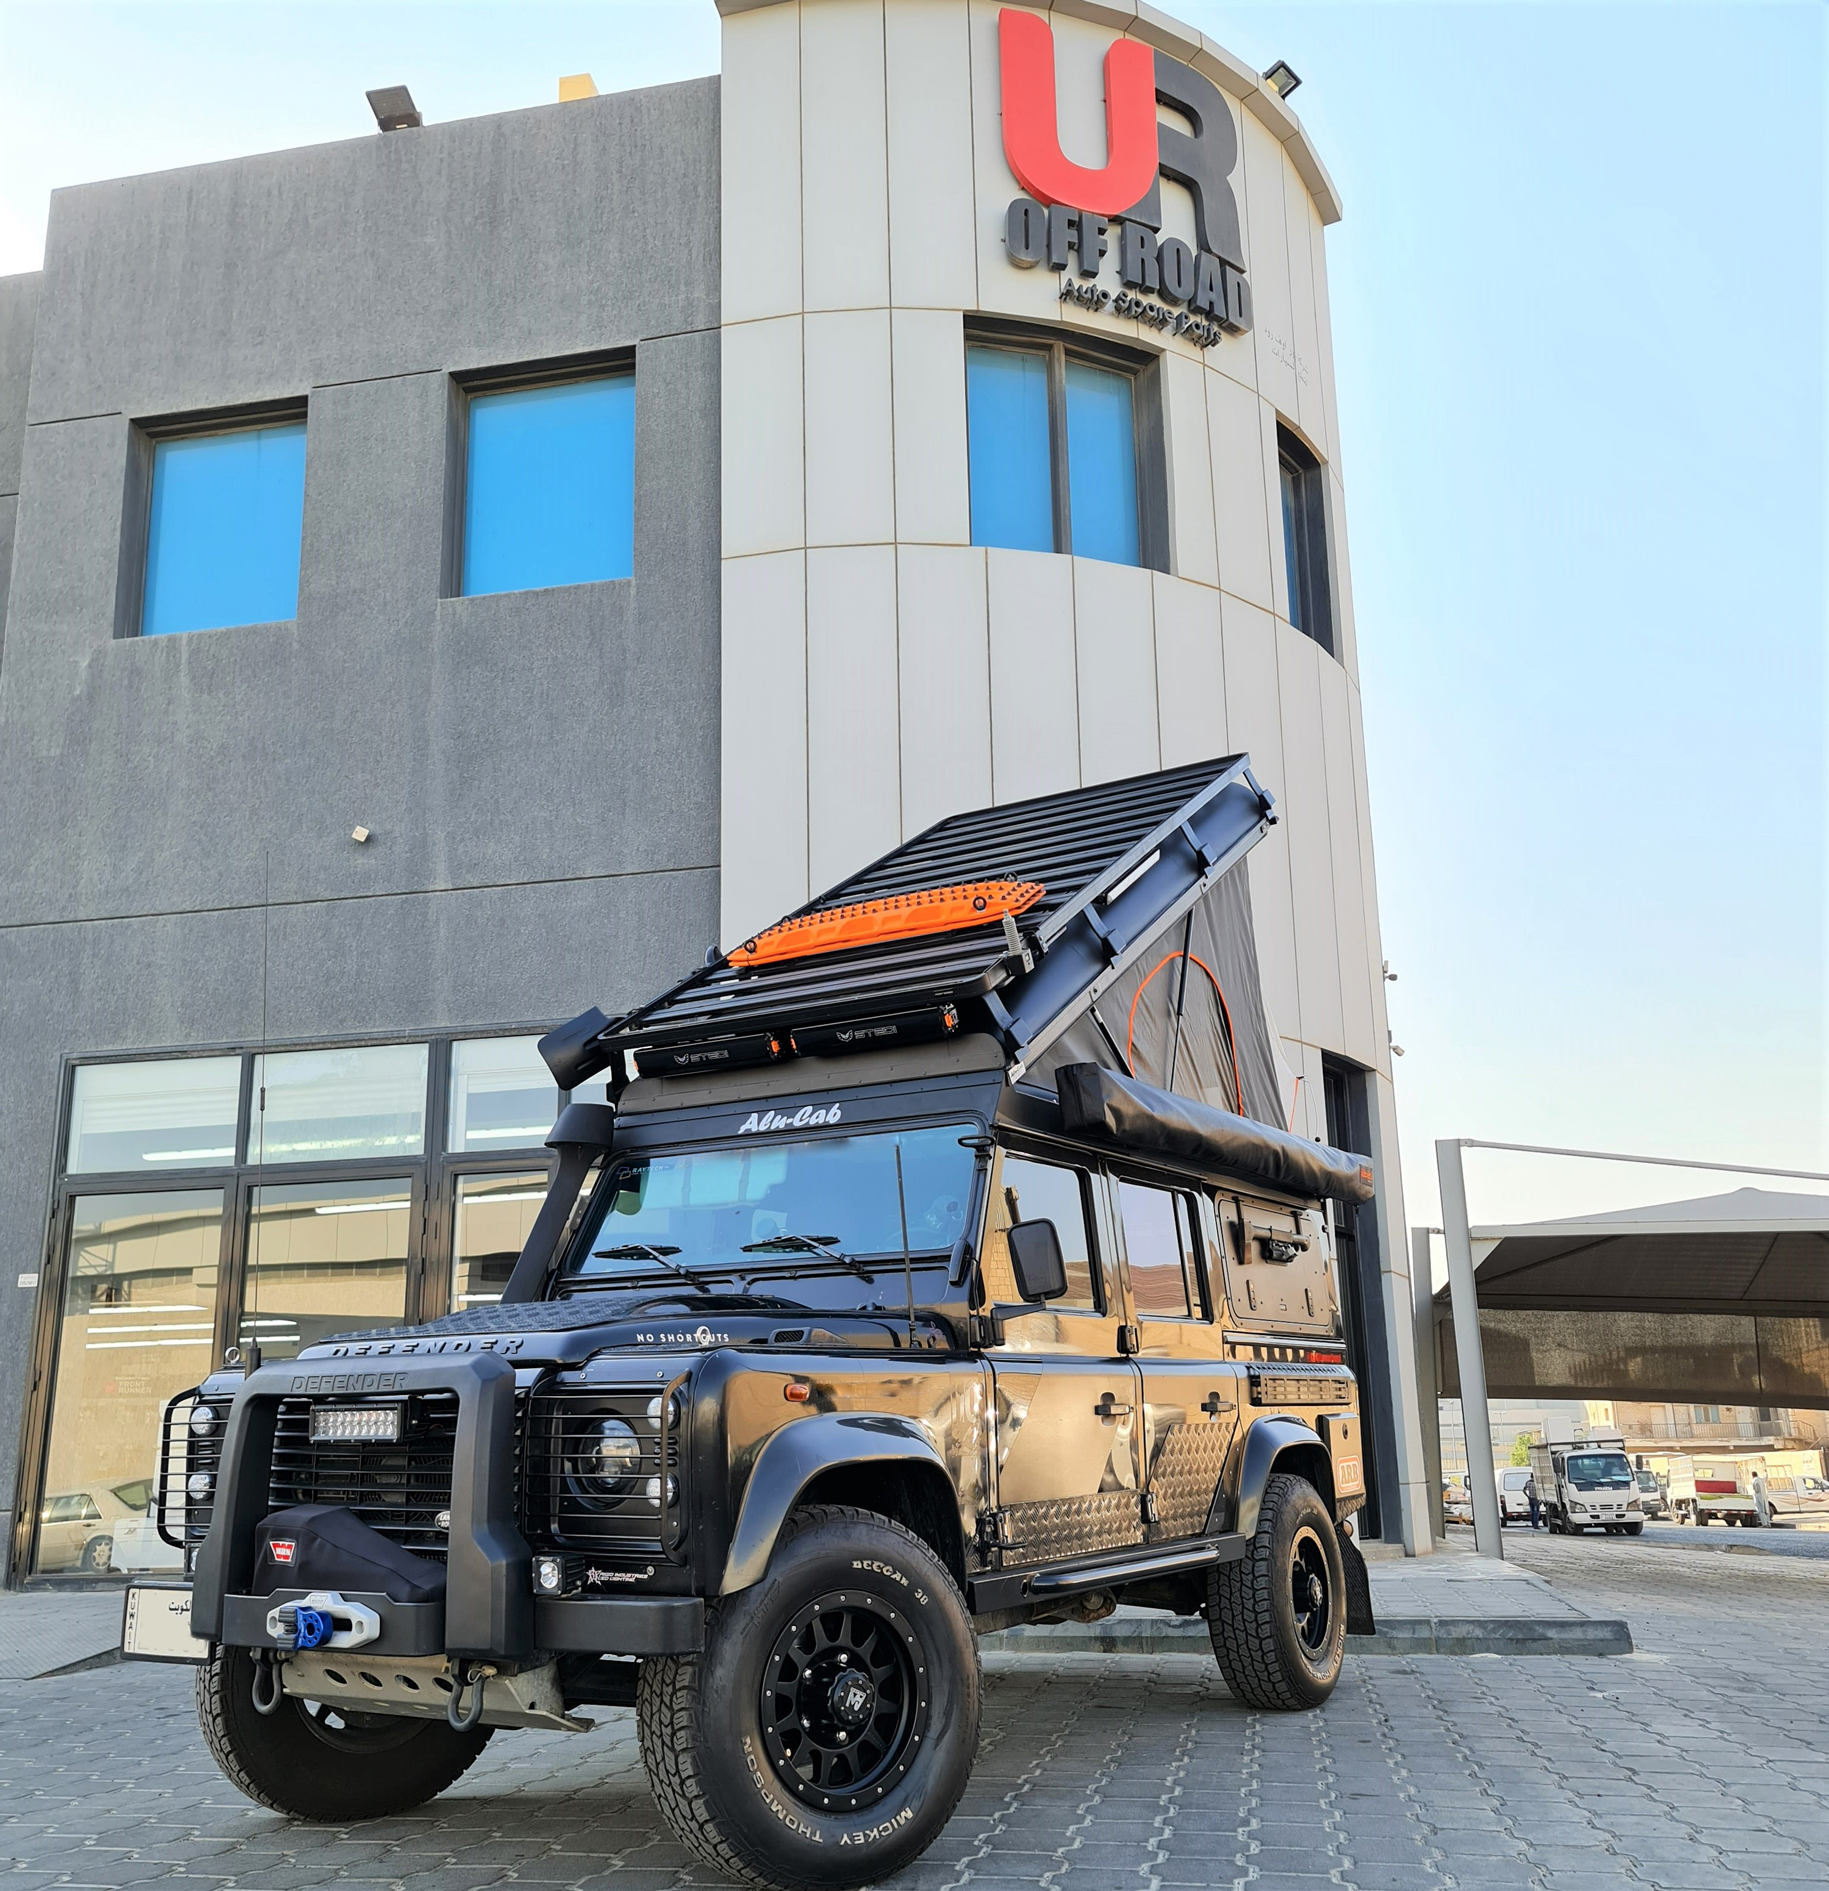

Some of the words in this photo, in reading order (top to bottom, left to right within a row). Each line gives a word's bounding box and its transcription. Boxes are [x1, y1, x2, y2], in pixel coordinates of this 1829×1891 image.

[998, 8, 1246, 273] UR
[1005, 198, 1109, 279] OFF
[1120, 221, 1253, 336] ROAD
[1061, 278, 1111, 311] Auto
[1113, 290, 1174, 333] Spare
[1173, 311, 1223, 348] Parts
[854, 1025, 898, 1039] STEDI
[690, 1050, 730, 1063] STEDI
[738, 1103, 842, 1134] Alu-Cab
[331, 1338, 525, 1357] DEFENDER
[636, 1333, 654, 1342] NO
[660, 1332, 730, 1343] SHORTCUTS
[290, 1372, 410, 1393] DEFENDER
[1340, 1463, 1359, 1485] ARB
[168, 1599, 192, 1615] لكويت
[127, 1591, 137, 1651] KUWAIT
[741, 1735, 824, 1843] THOMPSON
[840, 1806, 914, 1846] MICKEY
